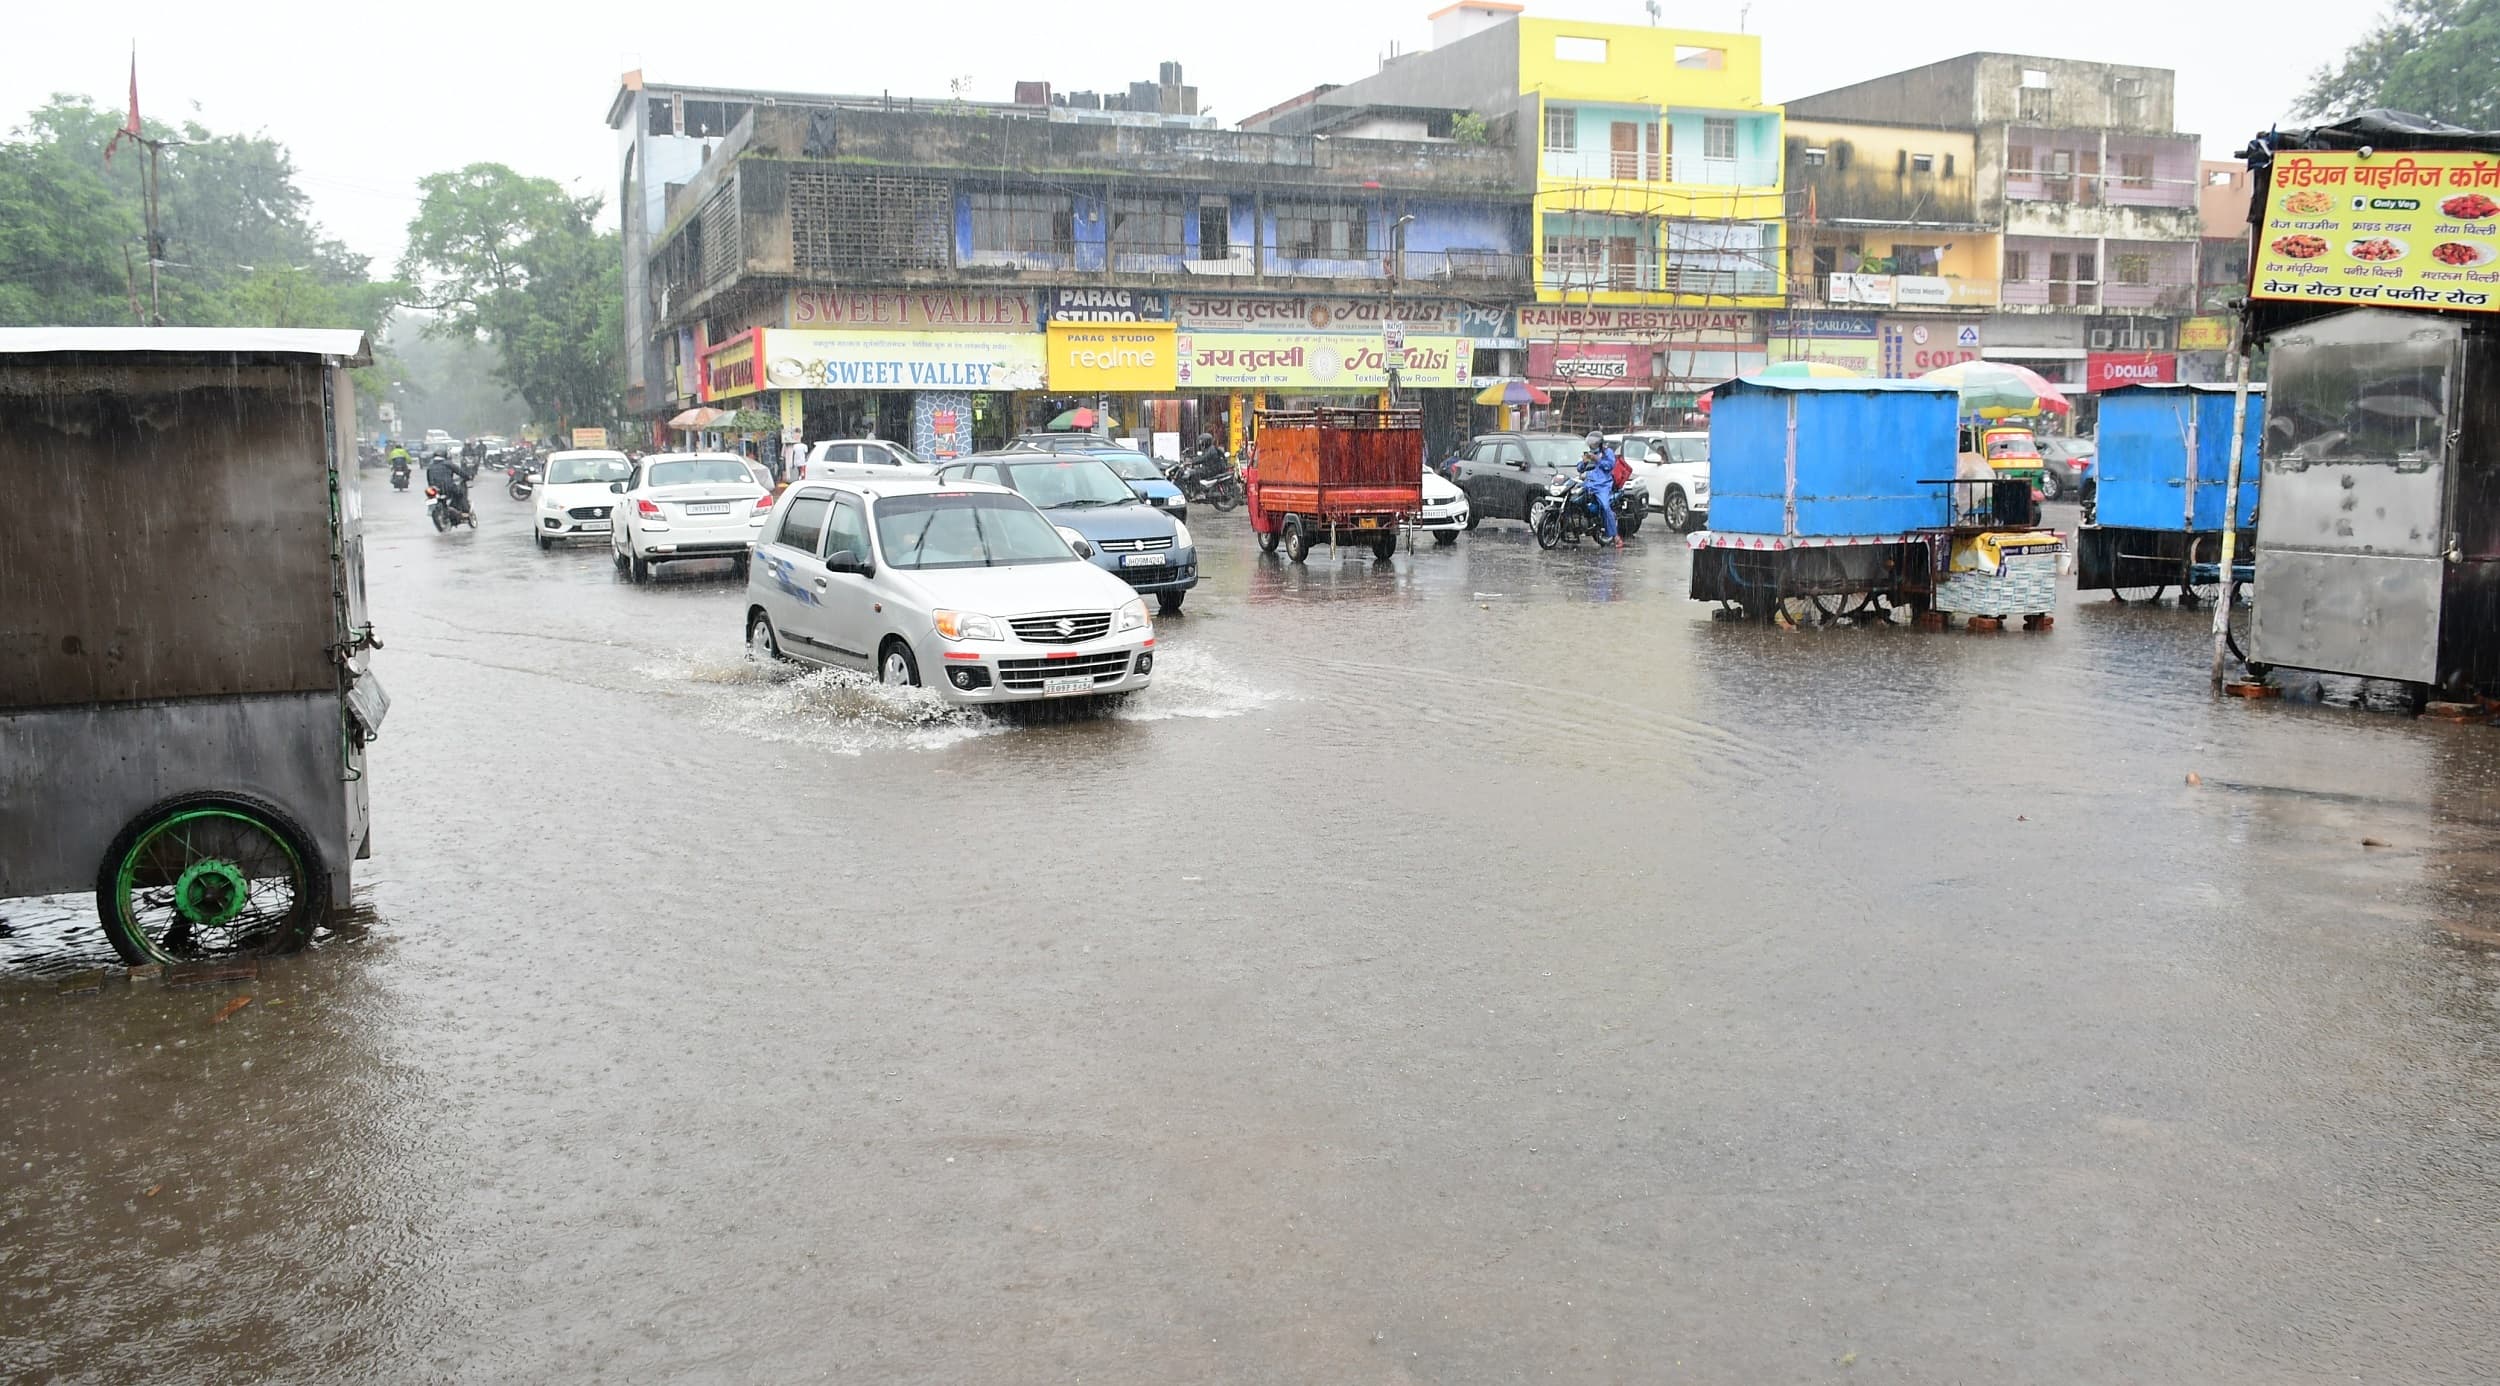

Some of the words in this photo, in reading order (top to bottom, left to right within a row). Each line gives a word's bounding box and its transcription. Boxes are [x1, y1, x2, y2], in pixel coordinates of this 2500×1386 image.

[2276, 158, 2348, 188] इंडियन
[2354, 158, 2443, 189] चाइनिज
[2374, 200, 2396, 209] Only
[2398, 200, 2417, 209] Veg
[2270, 219, 2290, 229] वेज
[1060, 289, 1131, 307] PARAG
[2264, 279, 2299, 293] वेज
[2305, 281, 2344, 296] रोल
[2349, 284, 2383, 298] एवं
[2386, 286, 2440, 301] पनीर
[2446, 288, 2489, 304] रोल
[796, 291, 912, 324] SWEET
[920, 294, 1031, 325] VALLEY
[1188, 299, 1232, 317] जय
[1237, 297, 1306, 322] तुलसी
[1521, 309, 1611, 327] RAINBOW
[1618, 311, 1748, 330] RESTAURANT
[1815, 320, 1850, 331] CARLO
[1070, 346, 1156, 369] realme
[1196, 349, 1235, 367] जय
[1239, 346, 1304, 372] तुलसी
[1344, 347, 1383, 371] Ja
[1915, 350, 1974, 369] GOLD
[827, 360, 903, 384] SWEET
[909, 361, 992, 385] VALLEY
[1355, 374, 1386, 383] Textiles
[1415, 374, 1440, 383] Room
[2115, 365, 2158, 378] DOLLAR
